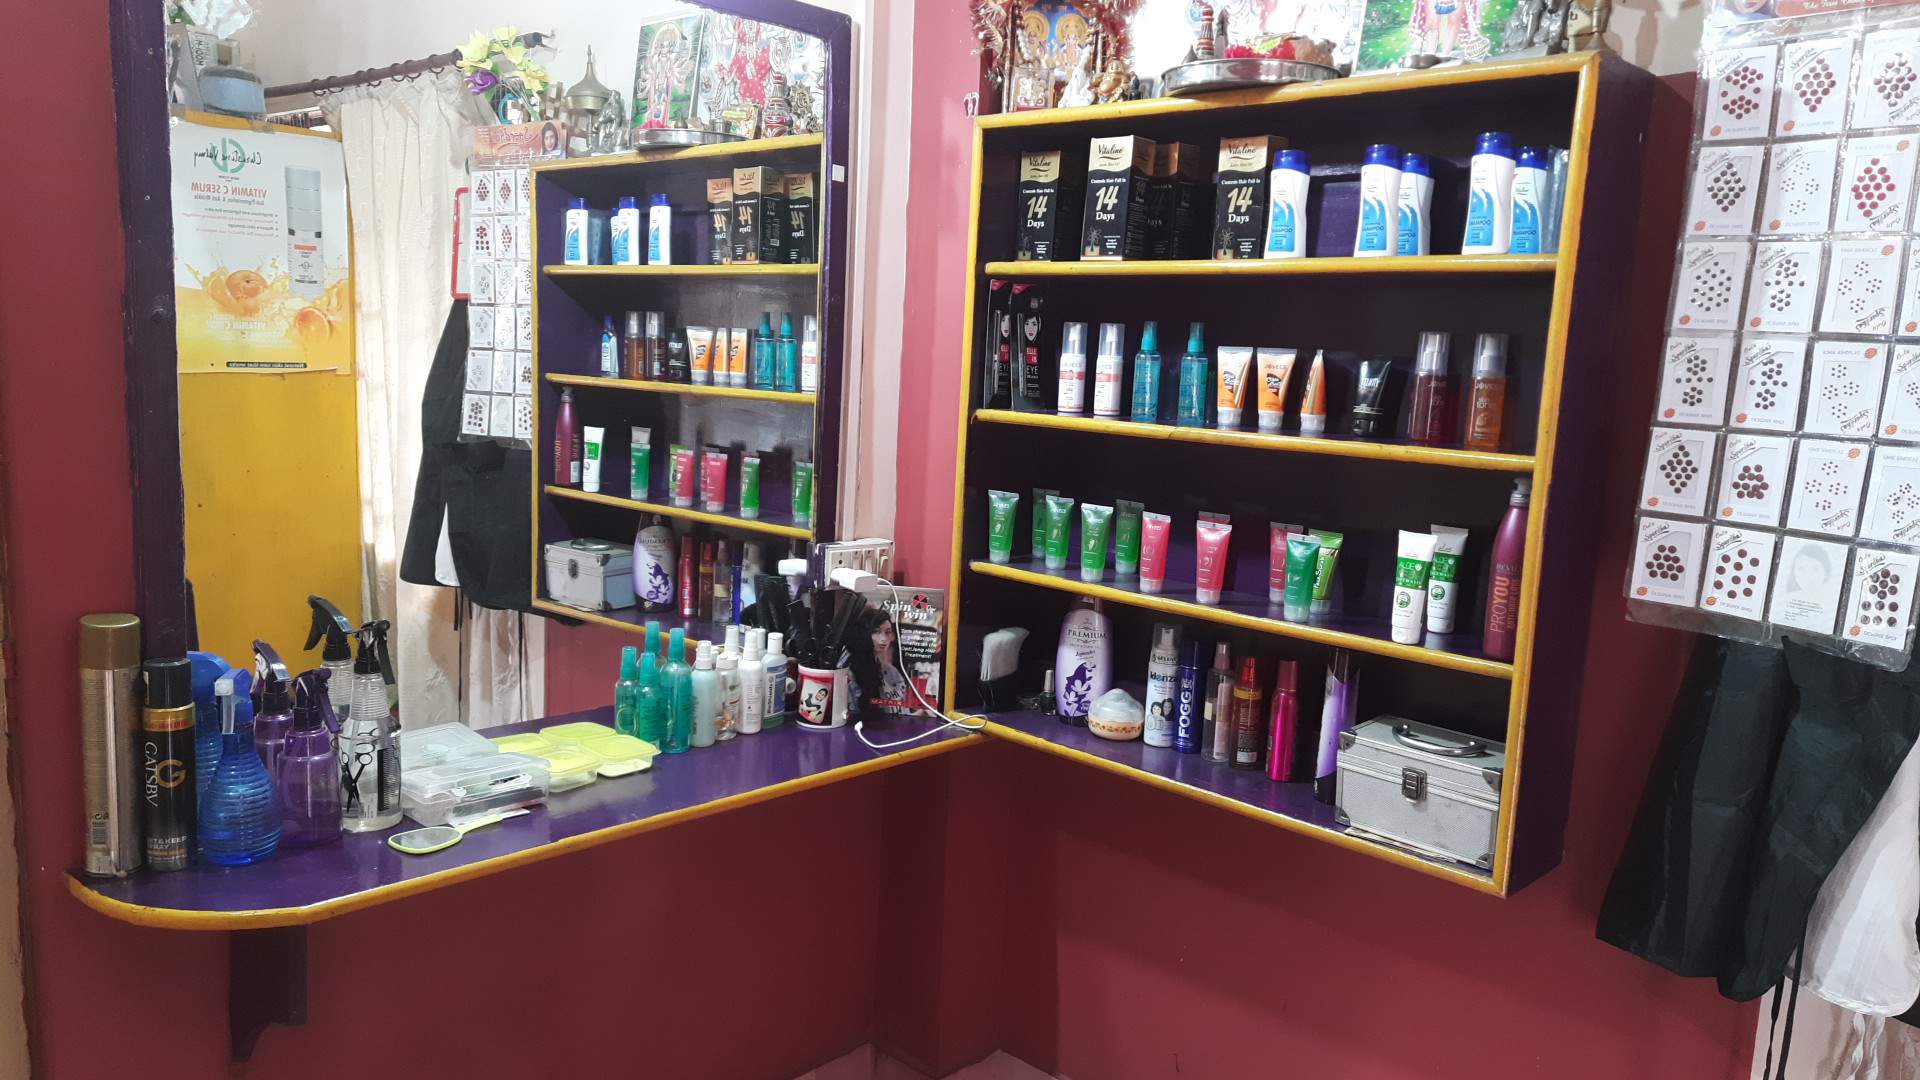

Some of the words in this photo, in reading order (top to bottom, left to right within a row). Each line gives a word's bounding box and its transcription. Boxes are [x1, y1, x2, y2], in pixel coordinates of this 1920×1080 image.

[1098, 144, 1123, 154] Vitaline
[1229, 143, 1256, 155] Vitaline
[1095, 185, 1119, 211] 14
[1227, 186, 1253, 213] 14
[1027, 195, 1048, 219] 14
[1095, 212, 1115, 221] Days
[1228, 214, 1250, 224] Days
[1027, 219, 1045, 228] Days
[1026, 365, 1038, 374] EYE
[1399, 561, 1415, 569] ALOE
[882, 600, 911, 613] Spin
[904, 610, 927, 620] win
[1067, 629, 1107, 639] PREMIUM
[1178, 689, 1193, 738] FOGG
[144, 741, 159, 807] GATSBY
[165, 835, 187, 844] KEEP
